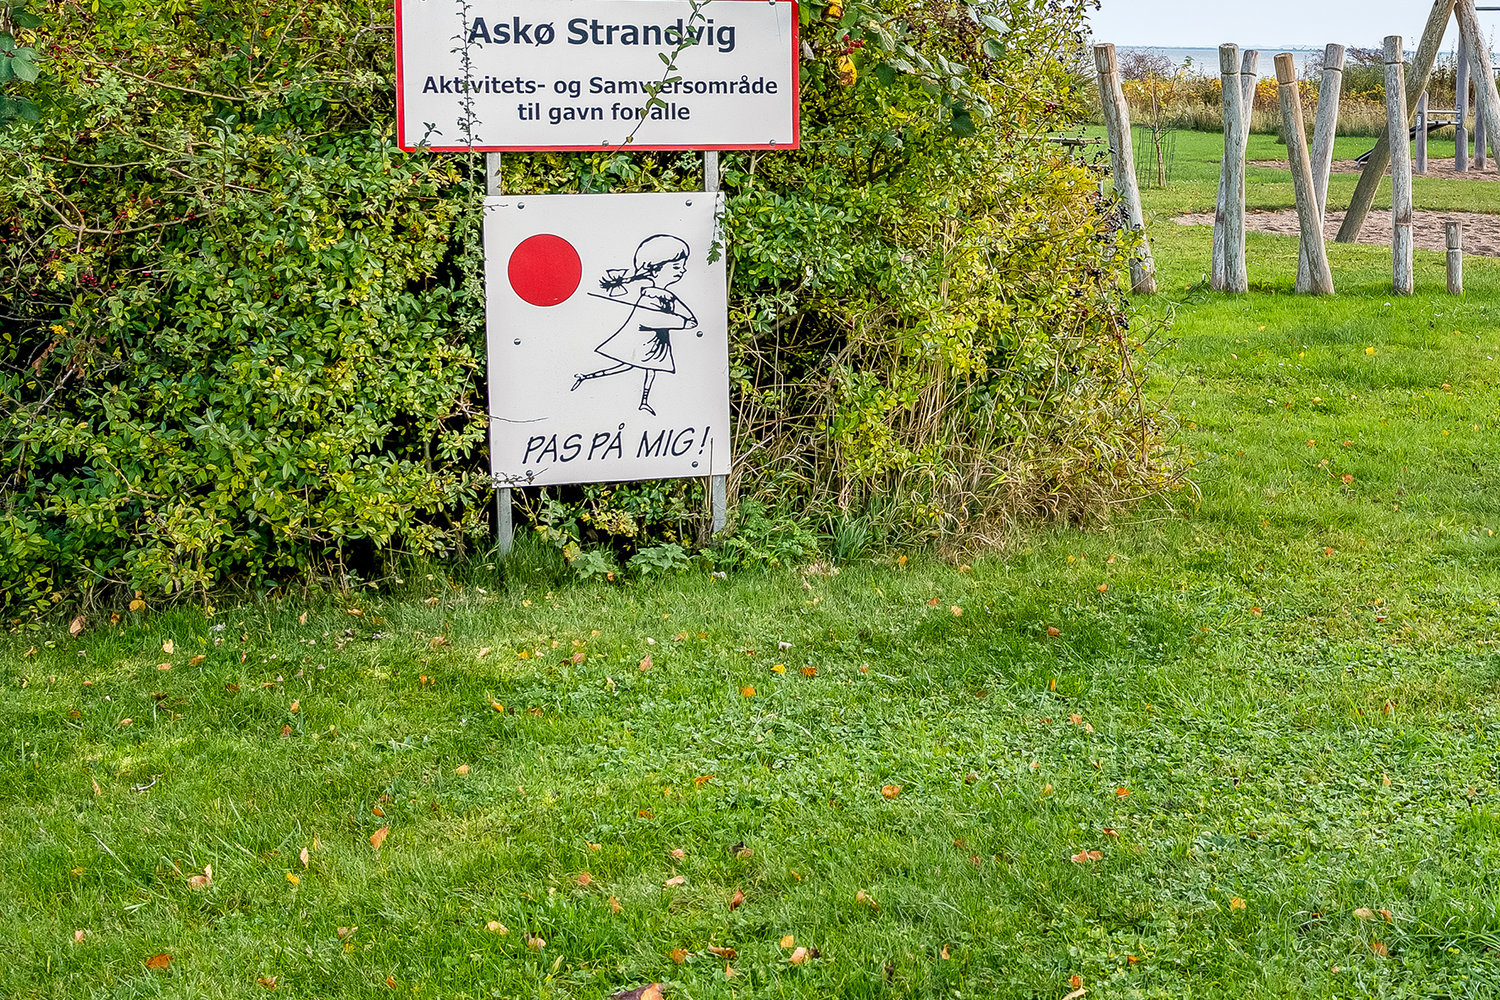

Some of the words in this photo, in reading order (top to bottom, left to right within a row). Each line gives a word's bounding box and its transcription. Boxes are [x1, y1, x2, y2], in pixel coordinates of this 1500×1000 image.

[467, 16, 555, 47] Askø
[567, 18, 736, 53] Strandvig
[553, 80, 581, 98] og
[517, 102, 540, 121] til
[548, 107, 604, 125] gavn
[611, 103, 646, 120] for
[650, 102, 690, 120] alle
[522, 433, 582, 464] PAS
[587, 422, 625, 460] PÅ
